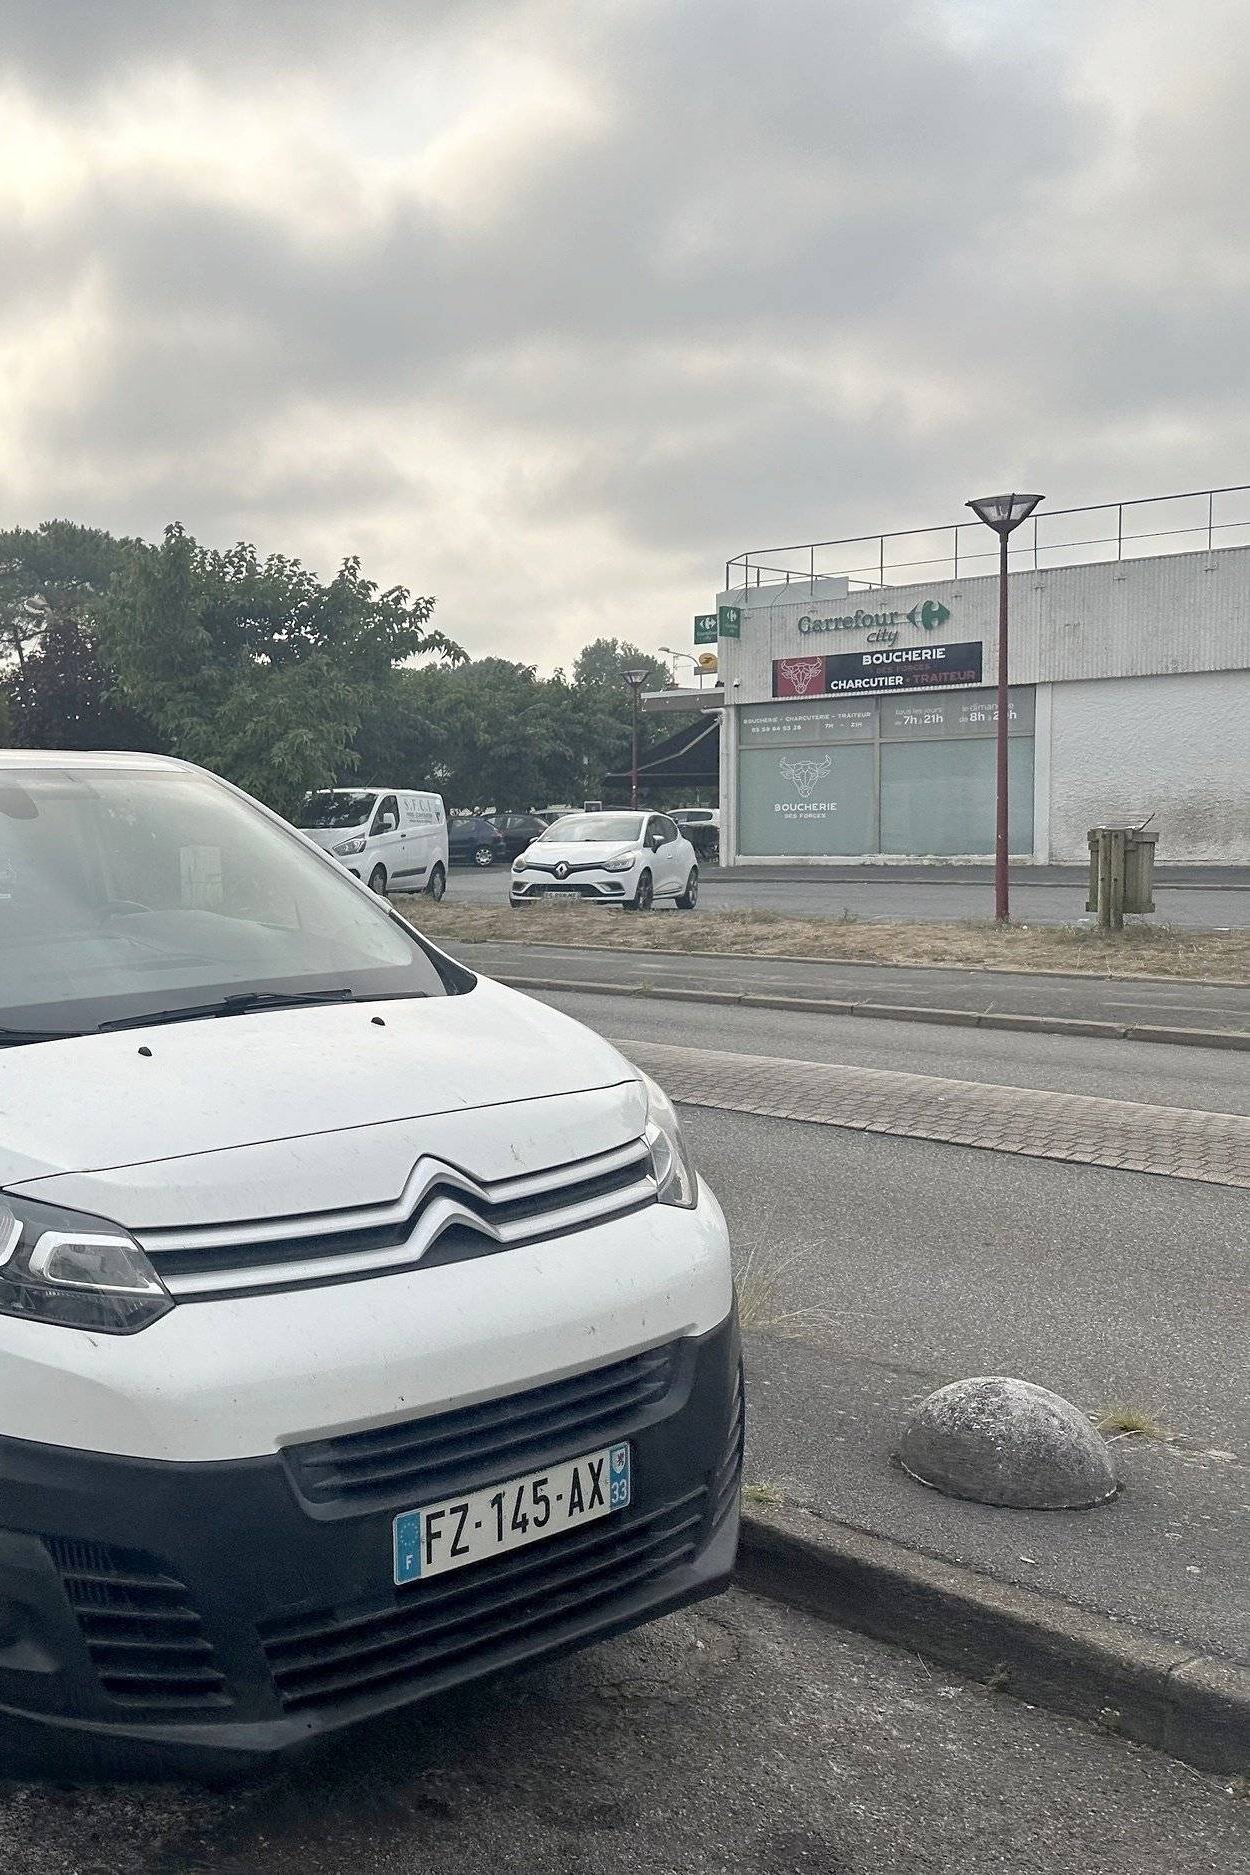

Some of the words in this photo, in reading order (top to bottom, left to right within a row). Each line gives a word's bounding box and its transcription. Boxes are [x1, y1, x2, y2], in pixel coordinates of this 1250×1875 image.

[798, 609, 898, 633] Carrefour
[867, 629, 898, 646] city
[862, 648, 946, 665] BOUCHERIE
[830, 676, 903, 690] CHARCUTIER
[912, 670, 976, 684] TRAITEUR
[743, 716, 778, 724] BOUCHERIE
[786, 714, 830, 722] CHARCUTERIE
[904, 715, 917, 725] 7h
[924, 714, 943, 724] 21h
[970, 712, 985, 722] 8h
[993, 710, 1017, 720] 2h
[774, 802, 838, 811] BOUCHERIE
[611, 1478, 627, 1504] 33
[426, 1458, 605, 1565] FZ-145-AX
[405, 1554, 414, 1570] F
